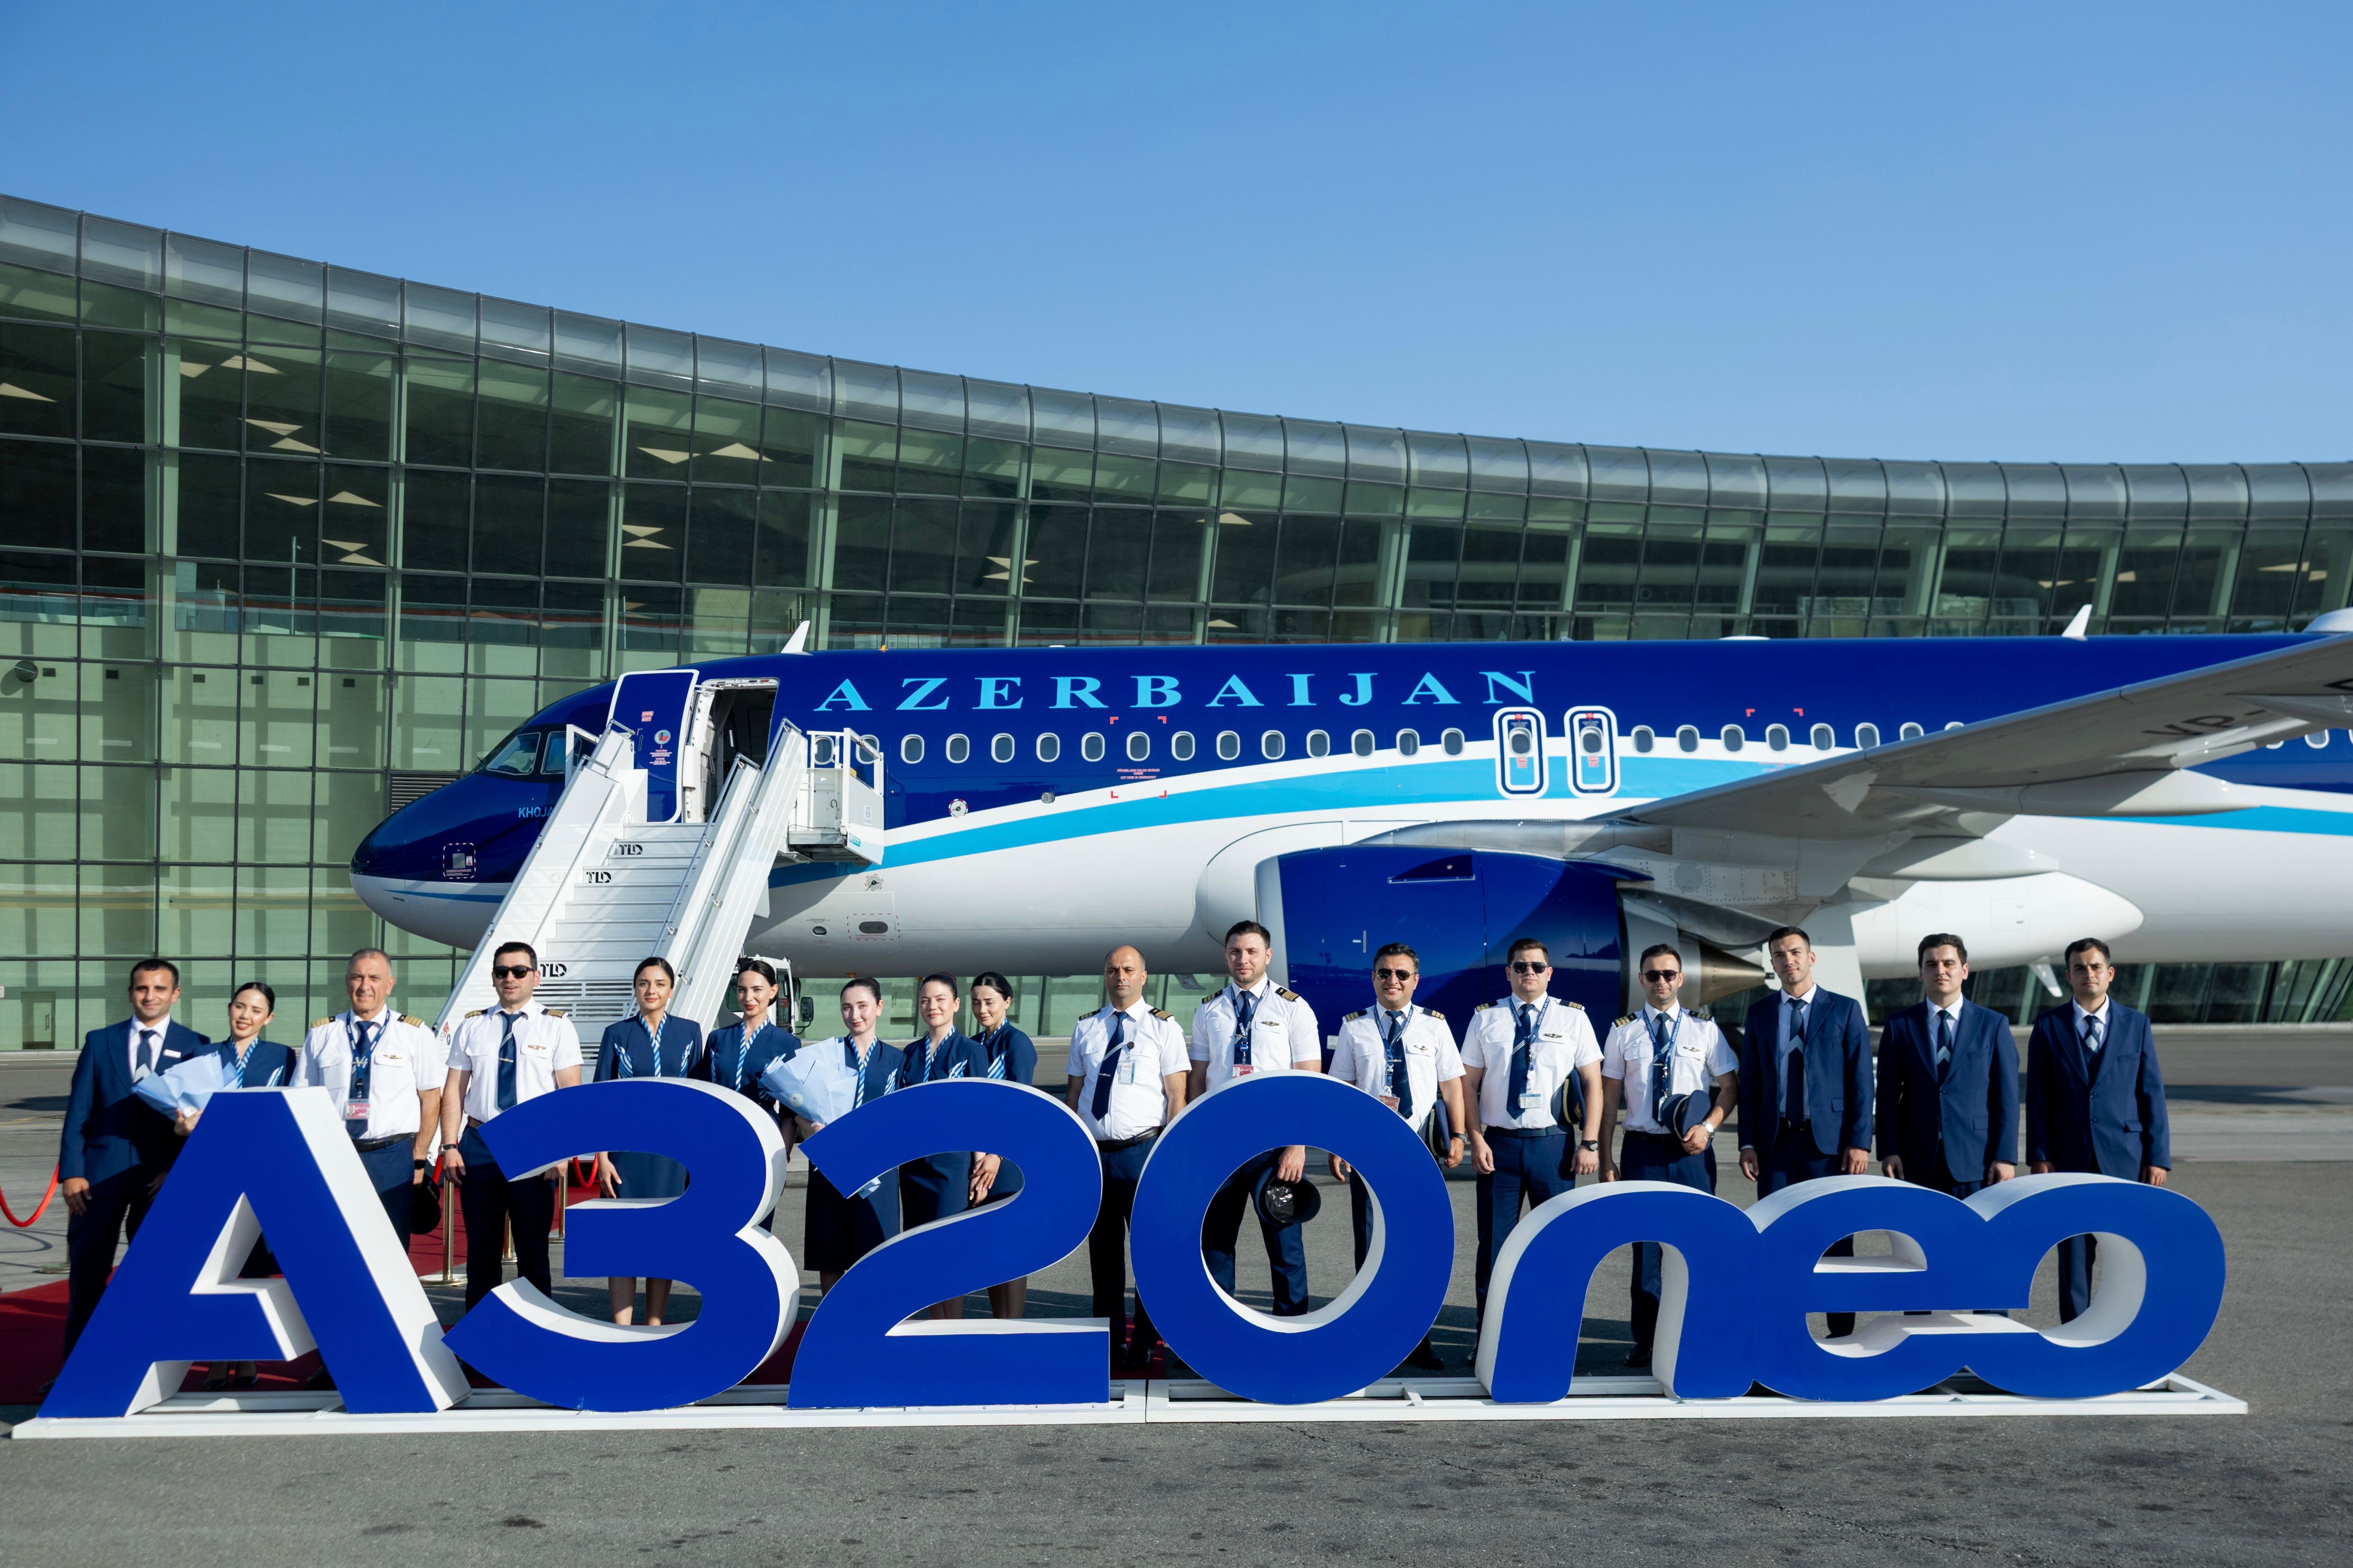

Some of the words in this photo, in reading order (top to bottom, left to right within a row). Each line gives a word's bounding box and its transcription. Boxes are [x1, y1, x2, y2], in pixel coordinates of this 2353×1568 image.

[813, 671, 1536, 711] AZERBAIJAN
[619, 844, 643, 855] TLD
[586, 871, 611, 883] TLD
[540, 963, 567, 977] TLD
